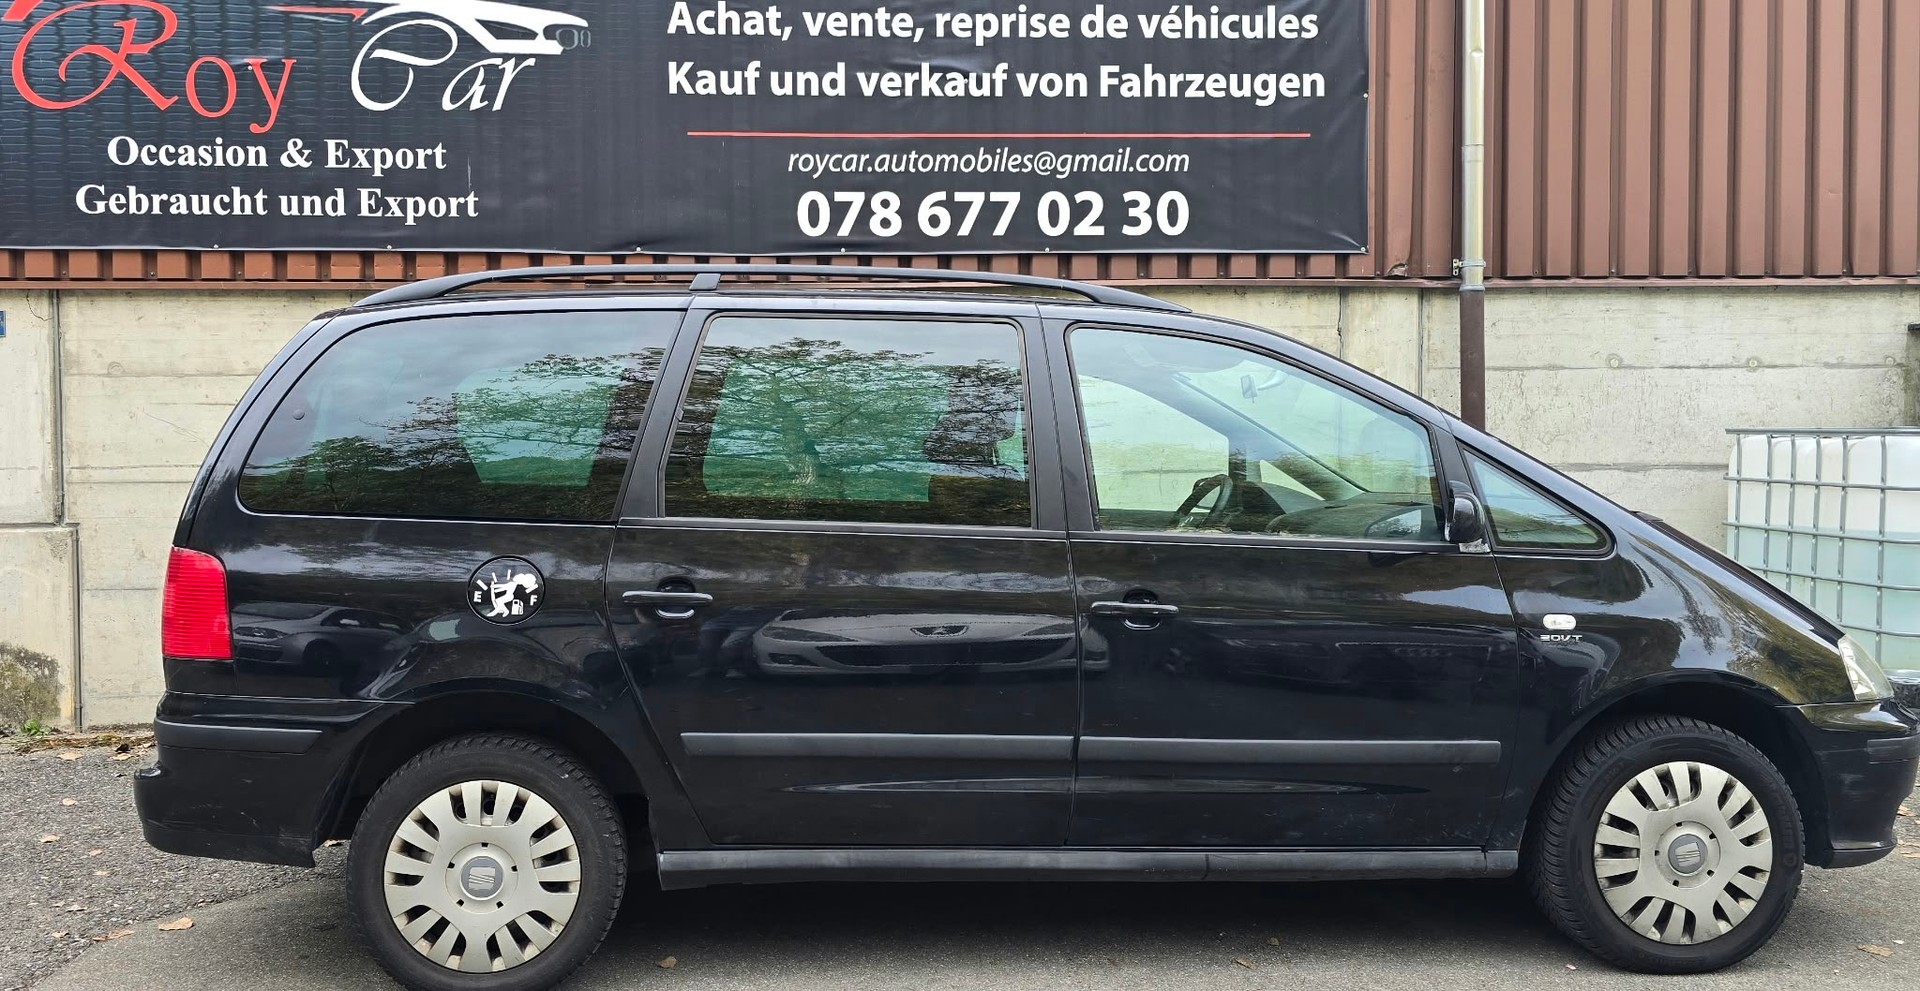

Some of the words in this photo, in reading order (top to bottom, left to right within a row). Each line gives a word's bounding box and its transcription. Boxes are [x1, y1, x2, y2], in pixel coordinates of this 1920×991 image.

[667, 1, 794, 43] Achat,
[802, 7, 926, 44] vente,
[935, 4, 1072, 46] reprise
[1081, 4, 1130, 40] de
[1138, 4, 1320, 40] véhicules
[11, 0, 297, 134] Roy
[351, 19, 537, 112] Car
[668, 61, 762, 97] Kauf
[771, 62, 847, 98] und
[857, 61, 1010, 99] verkauf
[1016, 73, 1089, 99] von
[1100, 64, 1327, 108] Fahrzeugen
[107, 136, 269, 168] Occasion
[280, 139, 314, 169] &
[326, 139, 448, 175] Export
[787, 147, 1191, 178] roycar.automobiles@gmail.com
[76, 185, 269, 218] Gebraucht
[279, 188, 348, 218] und
[357, 188, 480, 227] Export
[797, 191, 904, 239] 078
[917, 191, 1023, 239] 677
[1037, 191, 1106, 239] 02
[1121, 191, 1191, 238] 30
[473, 590, 482, 603] E
[529, 594, 538, 606] F
